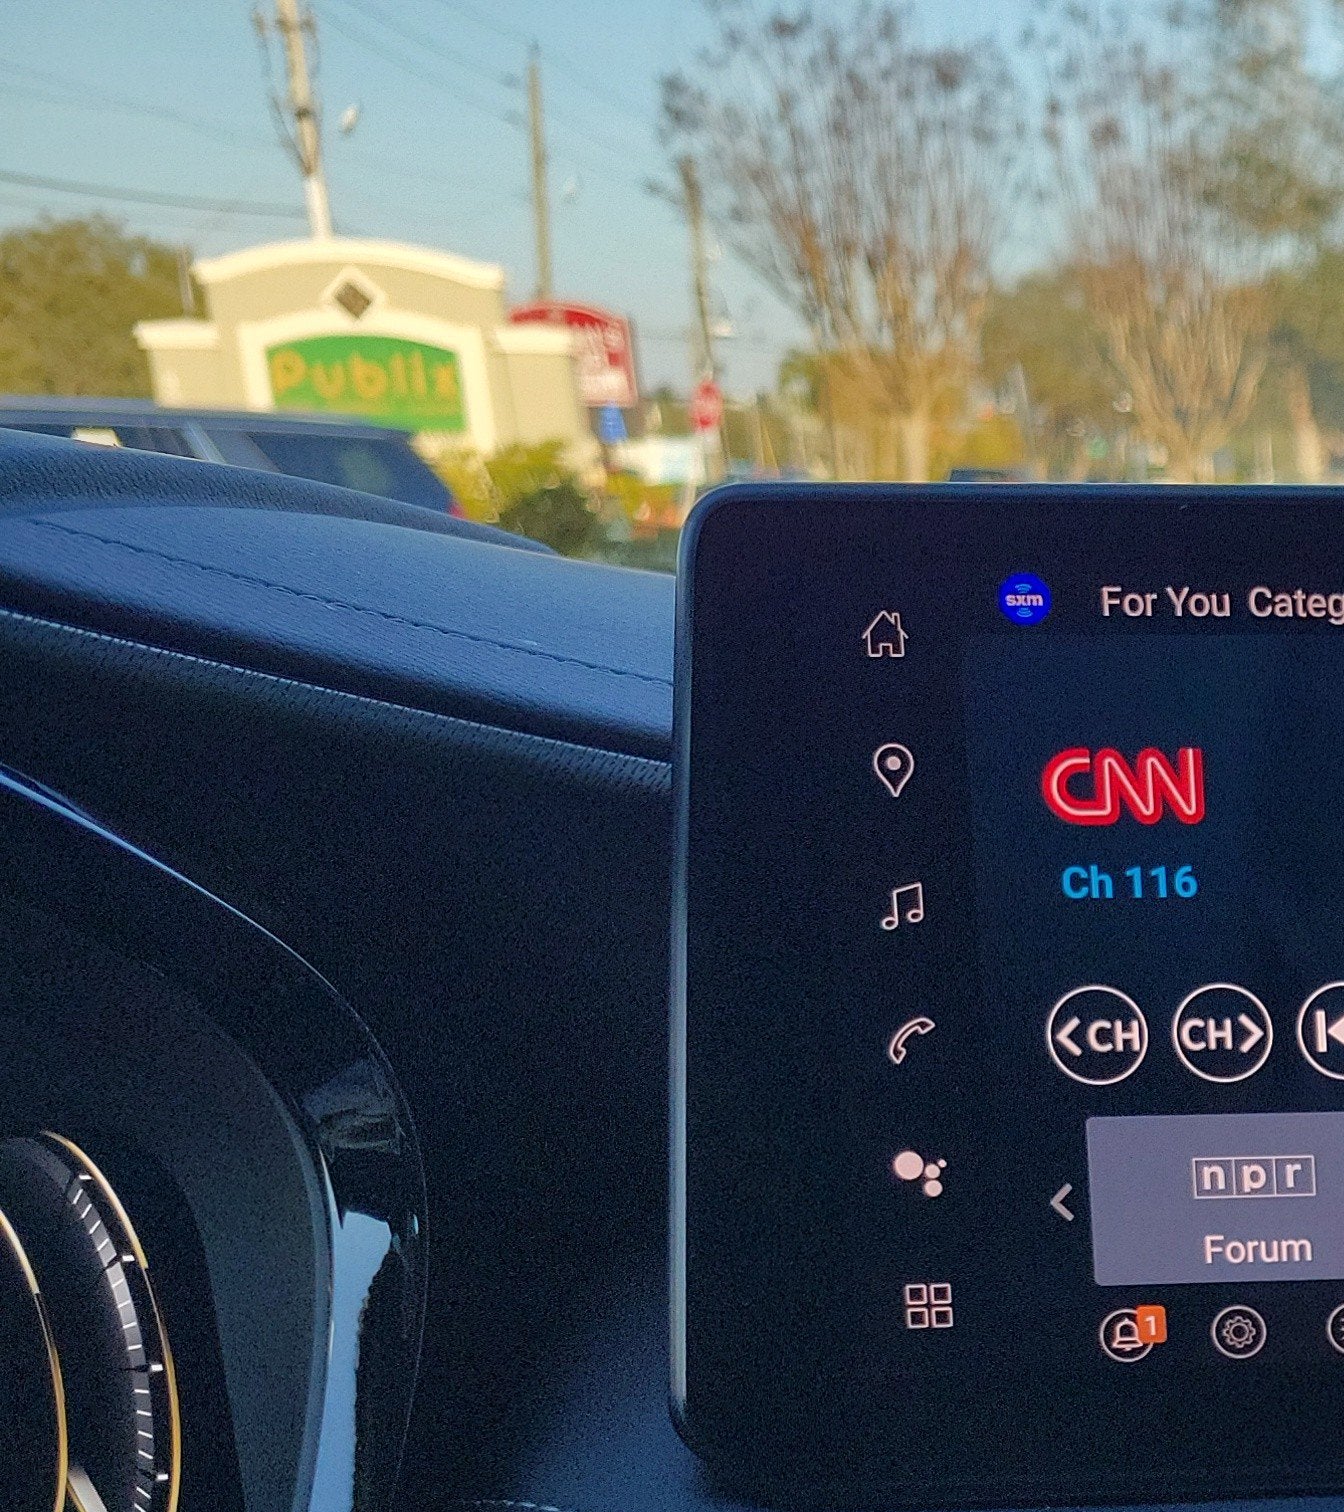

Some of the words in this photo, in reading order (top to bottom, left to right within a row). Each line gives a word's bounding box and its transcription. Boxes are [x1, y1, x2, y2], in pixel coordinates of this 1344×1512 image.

[271, 348, 460, 400] Publix
[1004, 592, 1045, 609] sxm
[1102, 586, 1157, 616] For
[1166, 587, 1230, 617] You
[1041, 747, 1206, 825] CNN
[1062, 864, 1113, 899] Ch
[1125, 865, 1197, 898] 116
[1201, 1158, 1302, 1193] npr
[1205, 1235, 1311, 1263] Forum
[1145, 1316, 1156, 1335] 1
